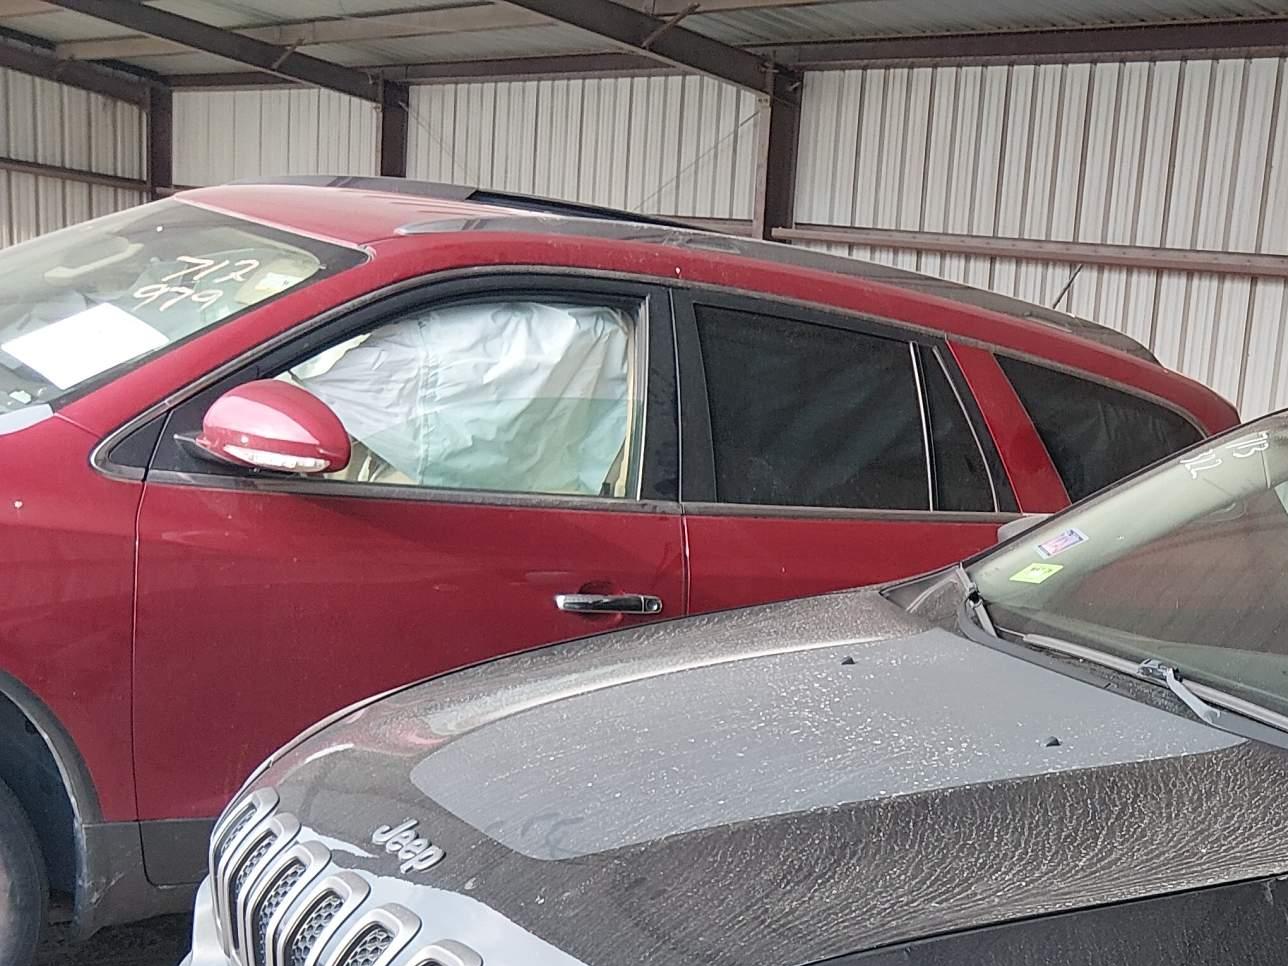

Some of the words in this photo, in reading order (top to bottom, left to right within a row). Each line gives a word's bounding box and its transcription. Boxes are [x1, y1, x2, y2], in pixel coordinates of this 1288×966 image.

[161, 256, 260, 283] 712
[130, 284, 223, 312] 979
[371, 818, 446, 875] Jeep
